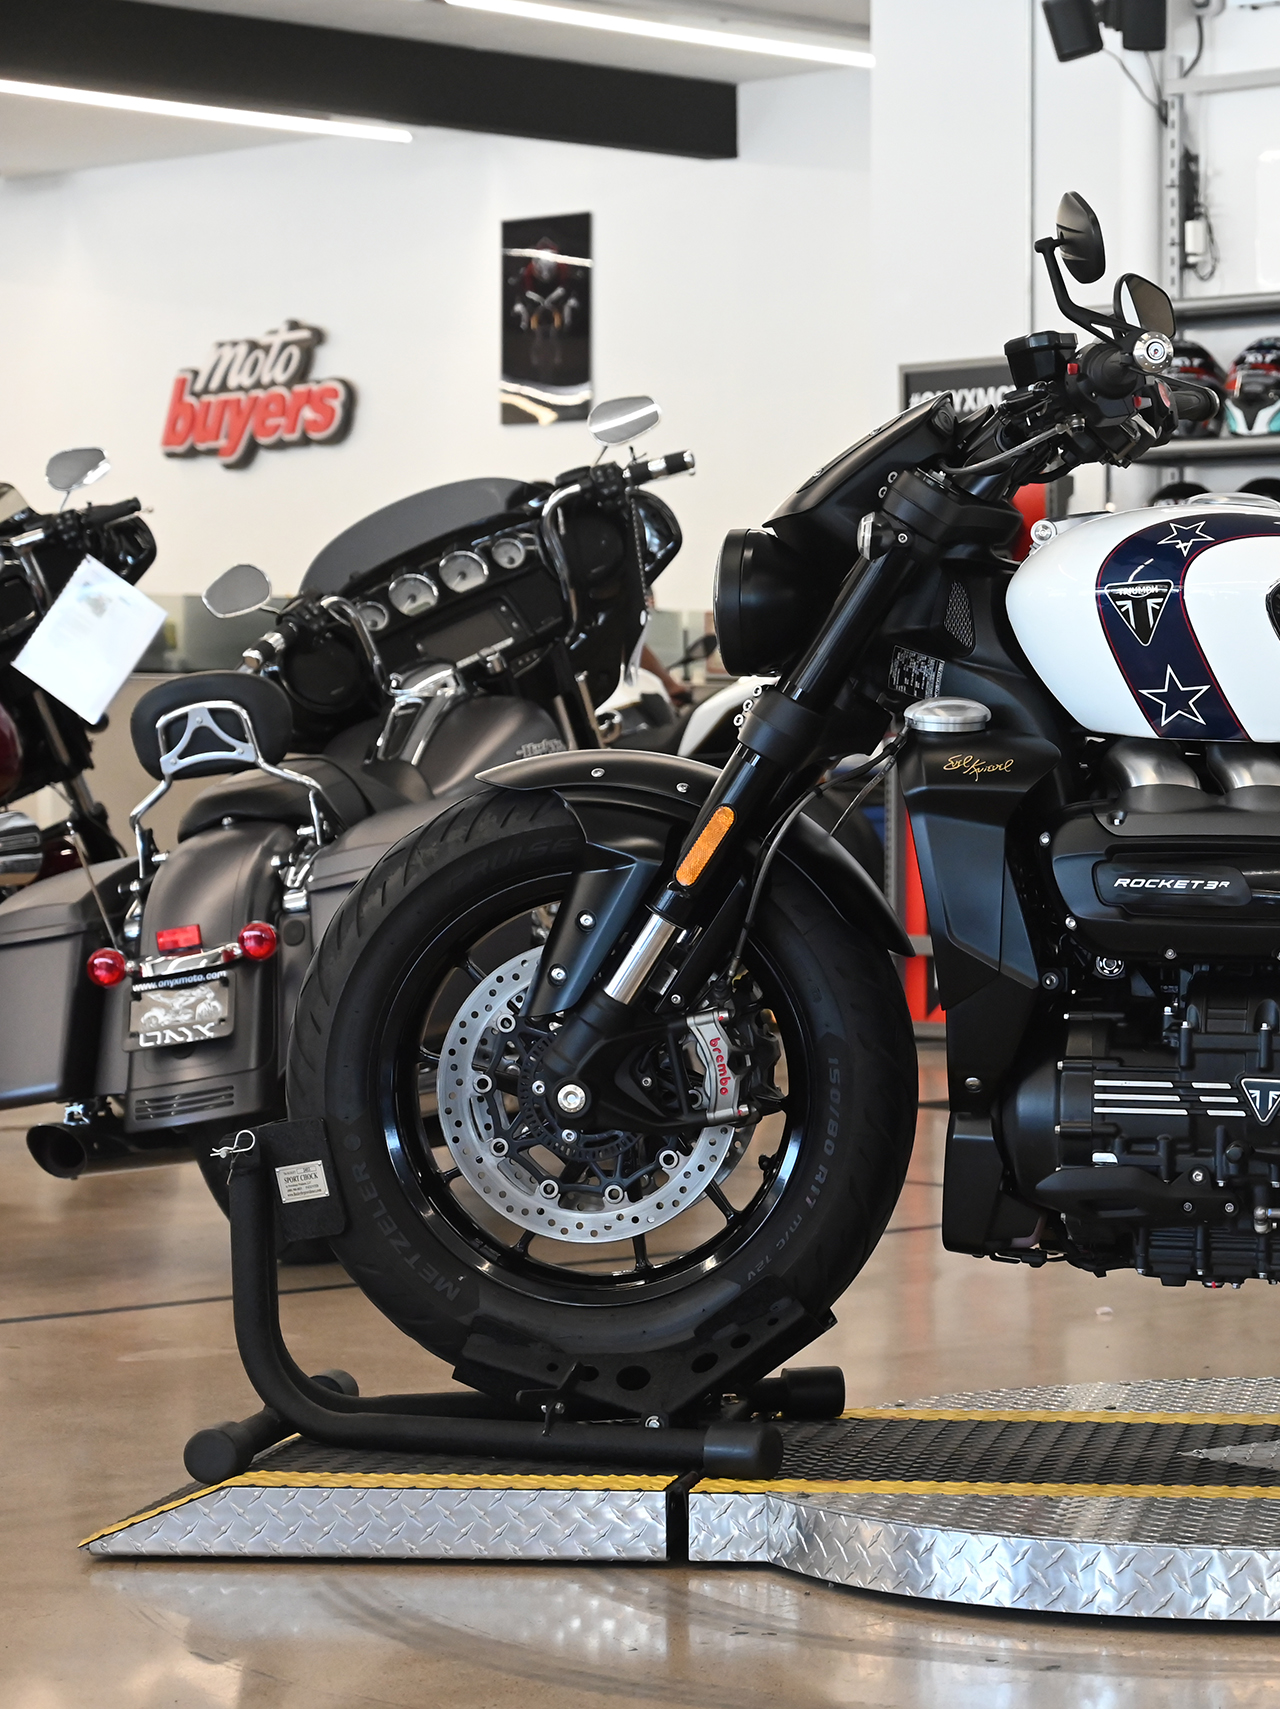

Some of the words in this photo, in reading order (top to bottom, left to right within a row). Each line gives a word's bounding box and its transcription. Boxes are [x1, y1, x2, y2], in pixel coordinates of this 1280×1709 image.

[193, 324, 313, 392] Moto
[162, 373, 342, 461] buyers
[1117, 585, 1159, 596] TRIUMPH
[709, 1037, 731, 1096] brembo
[823, 1056, 841, 1156] 150/80
[283, 1175, 300, 1184] SPORT
[300, 1172, 319, 1182] CHOCK
[805, 1164, 829, 1210] R17
[352, 1161, 462, 1302] METZELER
